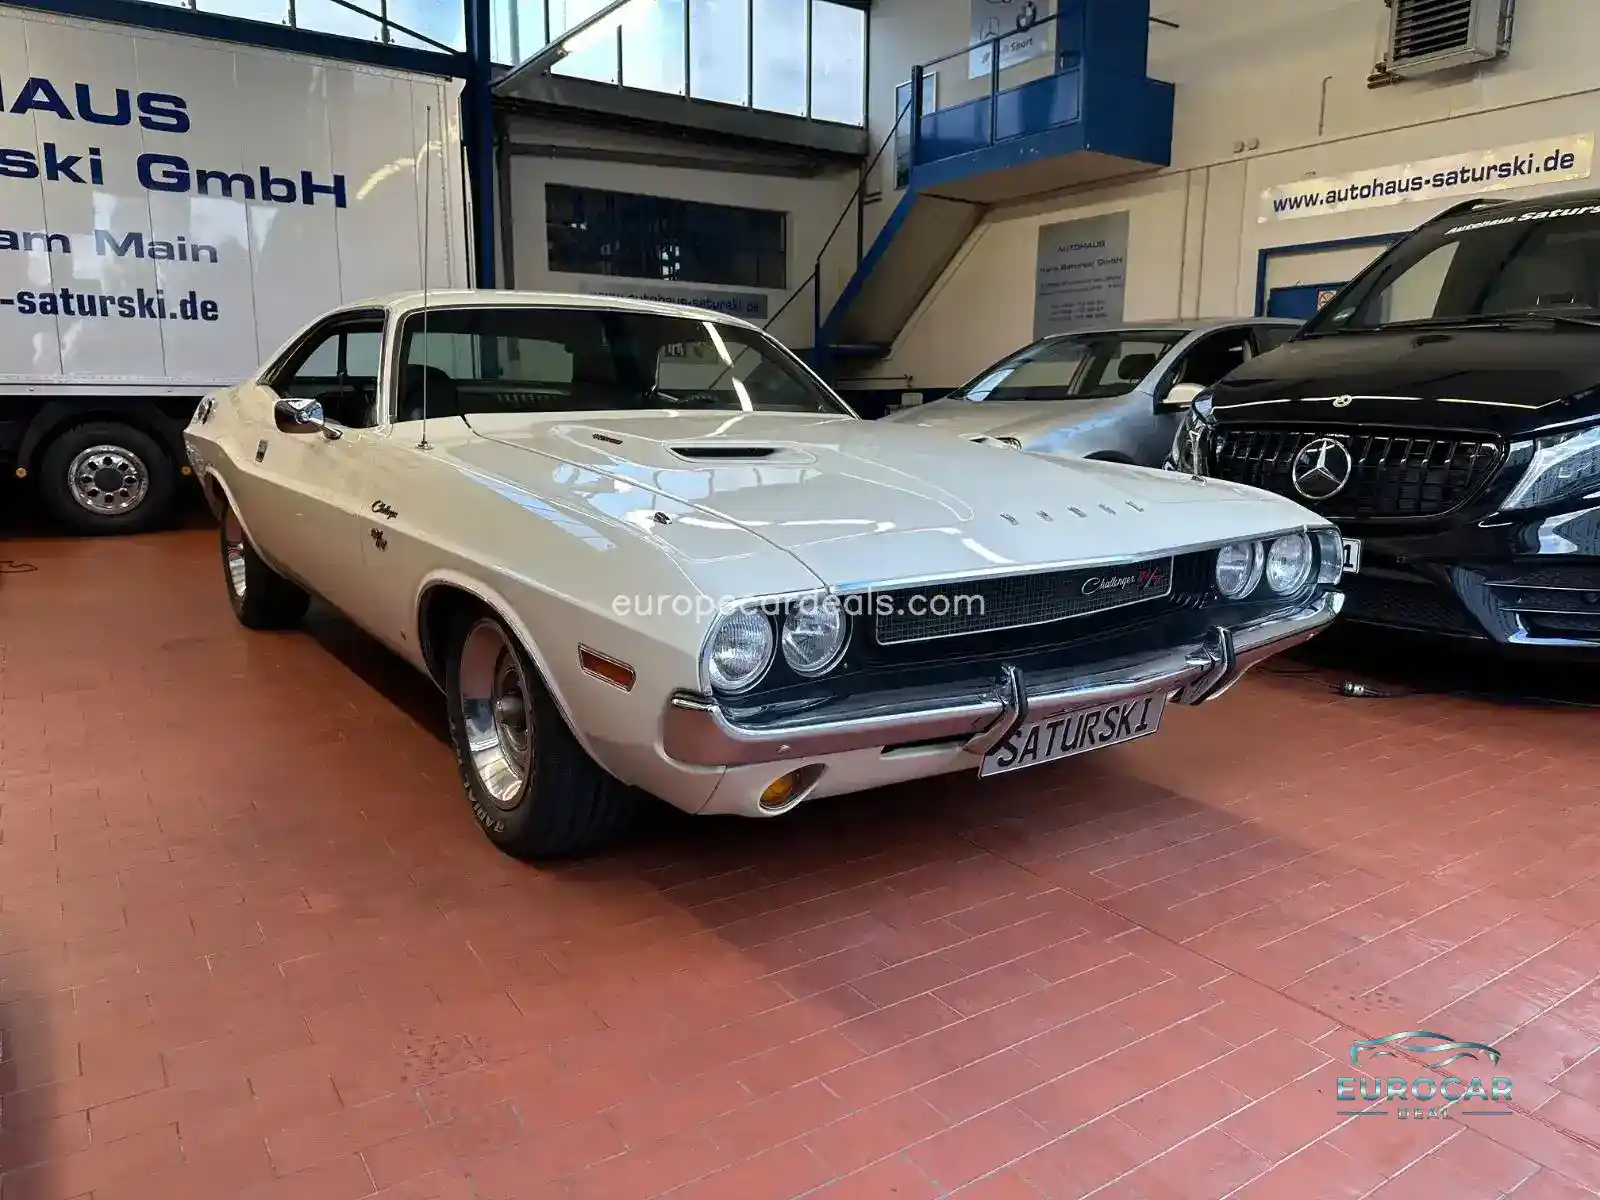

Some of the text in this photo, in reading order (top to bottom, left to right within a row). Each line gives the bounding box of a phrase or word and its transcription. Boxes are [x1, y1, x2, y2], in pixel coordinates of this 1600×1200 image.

[0, 74, 190, 133] AUS
[137, 153, 347, 209] GmbH
[1273, 149, 1575, 212] www.autohaus-saturski.de
[94, 229, 218, 263] Main
[1081, 576, 1136, 595] Challenger
[997, 698, 1152, 767] SATURSKI
